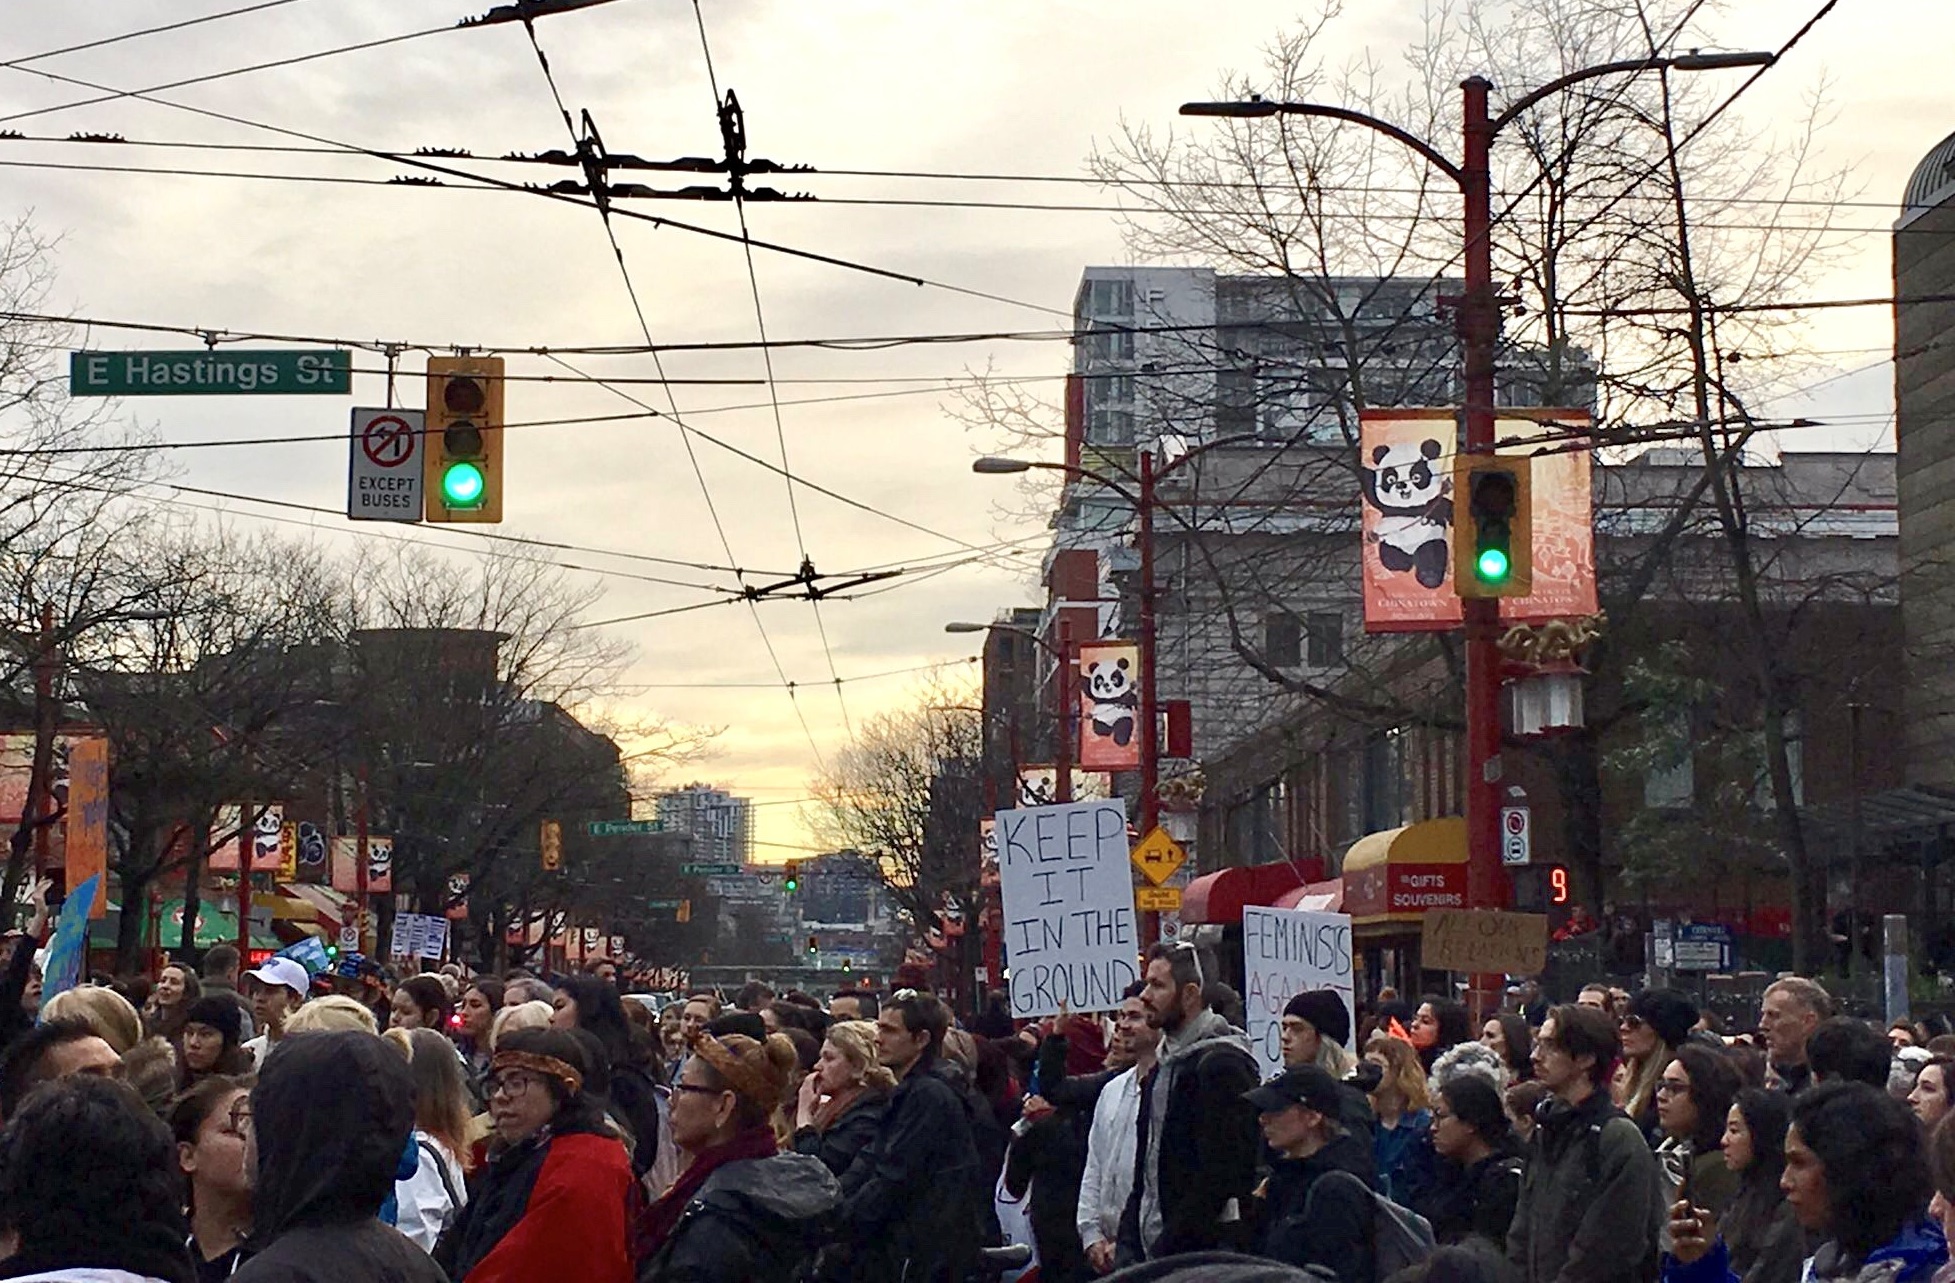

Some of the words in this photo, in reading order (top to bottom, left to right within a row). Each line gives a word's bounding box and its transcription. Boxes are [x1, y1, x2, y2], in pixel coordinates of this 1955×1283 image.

[87, 357, 109, 385] E
[126, 356, 278, 389] Hastings
[296, 356, 334, 384] St
[359, 476, 415, 491] EXCEPT
[362, 493, 411, 508] BUSES
[1004, 807, 1124, 865] KEEP
[1032, 866, 1094, 906] IT
[1410, 874, 1445, 888] GIFTS
[1552, 868, 1567, 902] 9
[1393, 893, 1462, 907] SOUVENIRS
[1011, 915, 1063, 956] IN
[1071, 908, 1130, 947] THE
[1246, 912, 1351, 976] FEMINISTS
[1011, 959, 1136, 1013] GROUND
[1247, 971, 1352, 1017] AGAT
